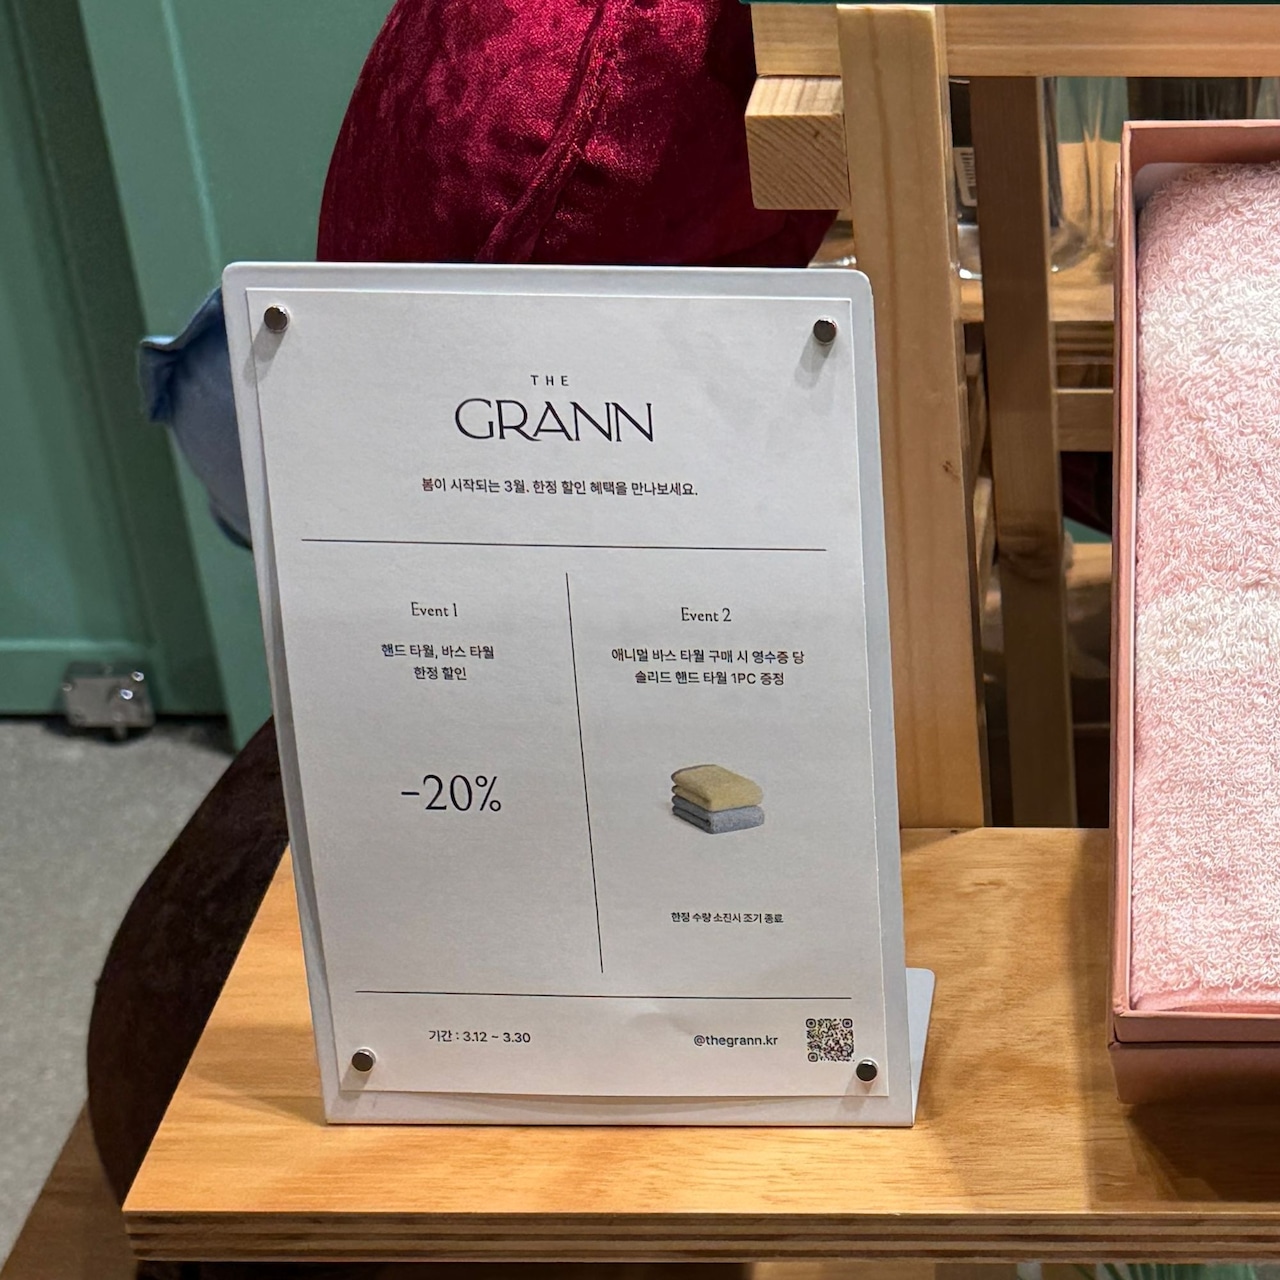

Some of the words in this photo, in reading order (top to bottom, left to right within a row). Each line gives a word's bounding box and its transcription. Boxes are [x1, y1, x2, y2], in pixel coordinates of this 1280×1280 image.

[530, 374, 569, 387] THE
[454, 397, 654, 443] GRANN
[422, 477, 447, 492] 봄이
[450, 478, 501, 493] 시작되는
[504, 479, 530, 494] 3월.
[532, 479, 557, 495] 한정
[561, 480, 587, 495] 할인
[590, 481, 628, 496] 혜택을
[631, 481, 698, 496] 만나보세요.
[410, 601, 449, 617] Event
[452, 602, 458, 617] 1
[681, 606, 719, 622] Event
[722, 607, 732, 622] 2
[381, 643, 407, 658] 핸드
[409, 644, 438, 660] 타월,
[441, 645, 467, 659] 바스
[469, 645, 494, 660] 타월
[611, 647, 649, 662] 애니멀
[652, 649, 677, 663] 바스
[680, 649, 705, 663] 타월
[708, 649, 733, 664] 구매
[736, 650, 748, 664] 시
[751, 650, 789, 665] 영수증
[792, 650, 805, 665] 당
[413, 666, 439, 680] 한정
[441, 666, 467, 681] 할인
[675, 671, 700, 685] 핸드
[703, 671, 728, 685] 타월
[730, 672, 756, 685] 1PC
[760, 672, 784, 686] 증정
[400, 774, 502, 812] -20%
[671, 911, 690, 923] 한정
[692, 912, 712, 923] 수량
[713, 912, 742, 923] 소진시
[743, 913, 762, 924] 조기
[764, 913, 784, 924] 종료
[428, 1029, 453, 1043] 기간
[462, 1031, 488, 1043] 3.12
[503, 1032, 531, 1043] 3.30
[693, 1034, 779, 1048] @thegrann.kr
